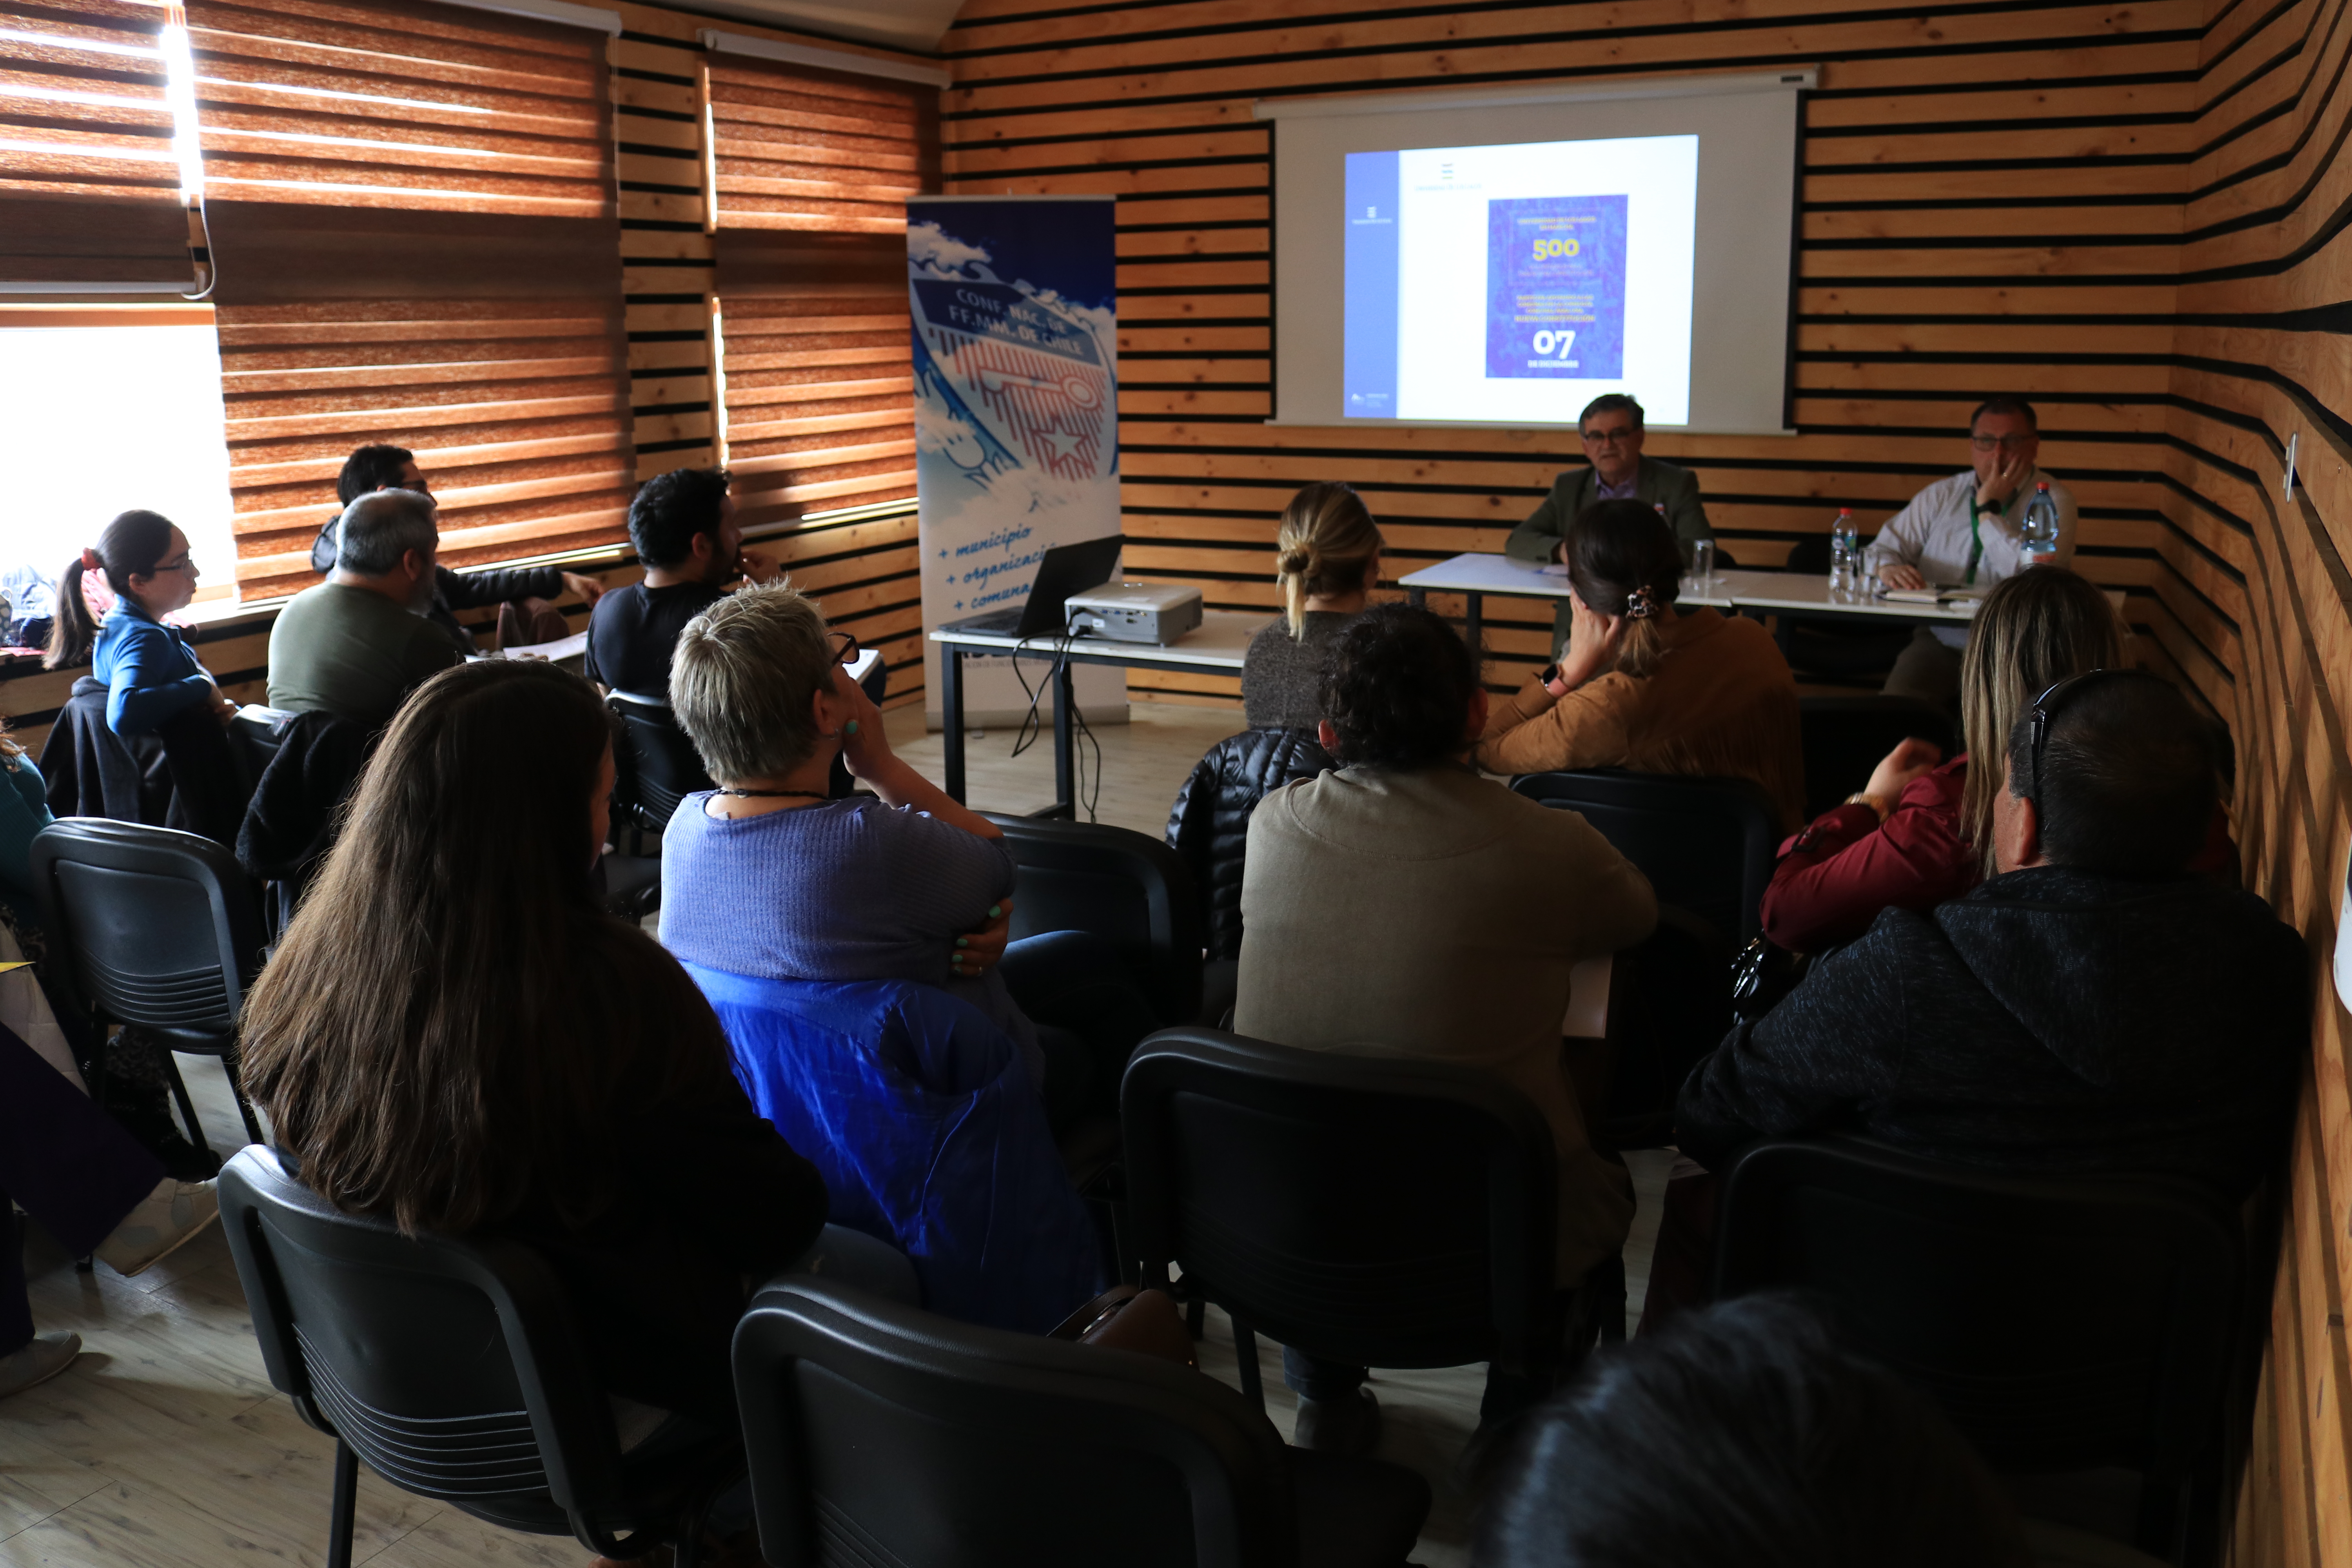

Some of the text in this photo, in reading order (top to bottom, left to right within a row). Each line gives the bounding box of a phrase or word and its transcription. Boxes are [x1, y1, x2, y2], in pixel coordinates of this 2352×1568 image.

[1533, 239, 1580, 261] 500
[1018, 325, 1039, 343] DE
[1042, 333, 1083, 356] CHILE
[1533, 329, 1576, 360] 07
[956, 523, 1033, 557] municipio
[963, 543, 1056, 590] organizaci
